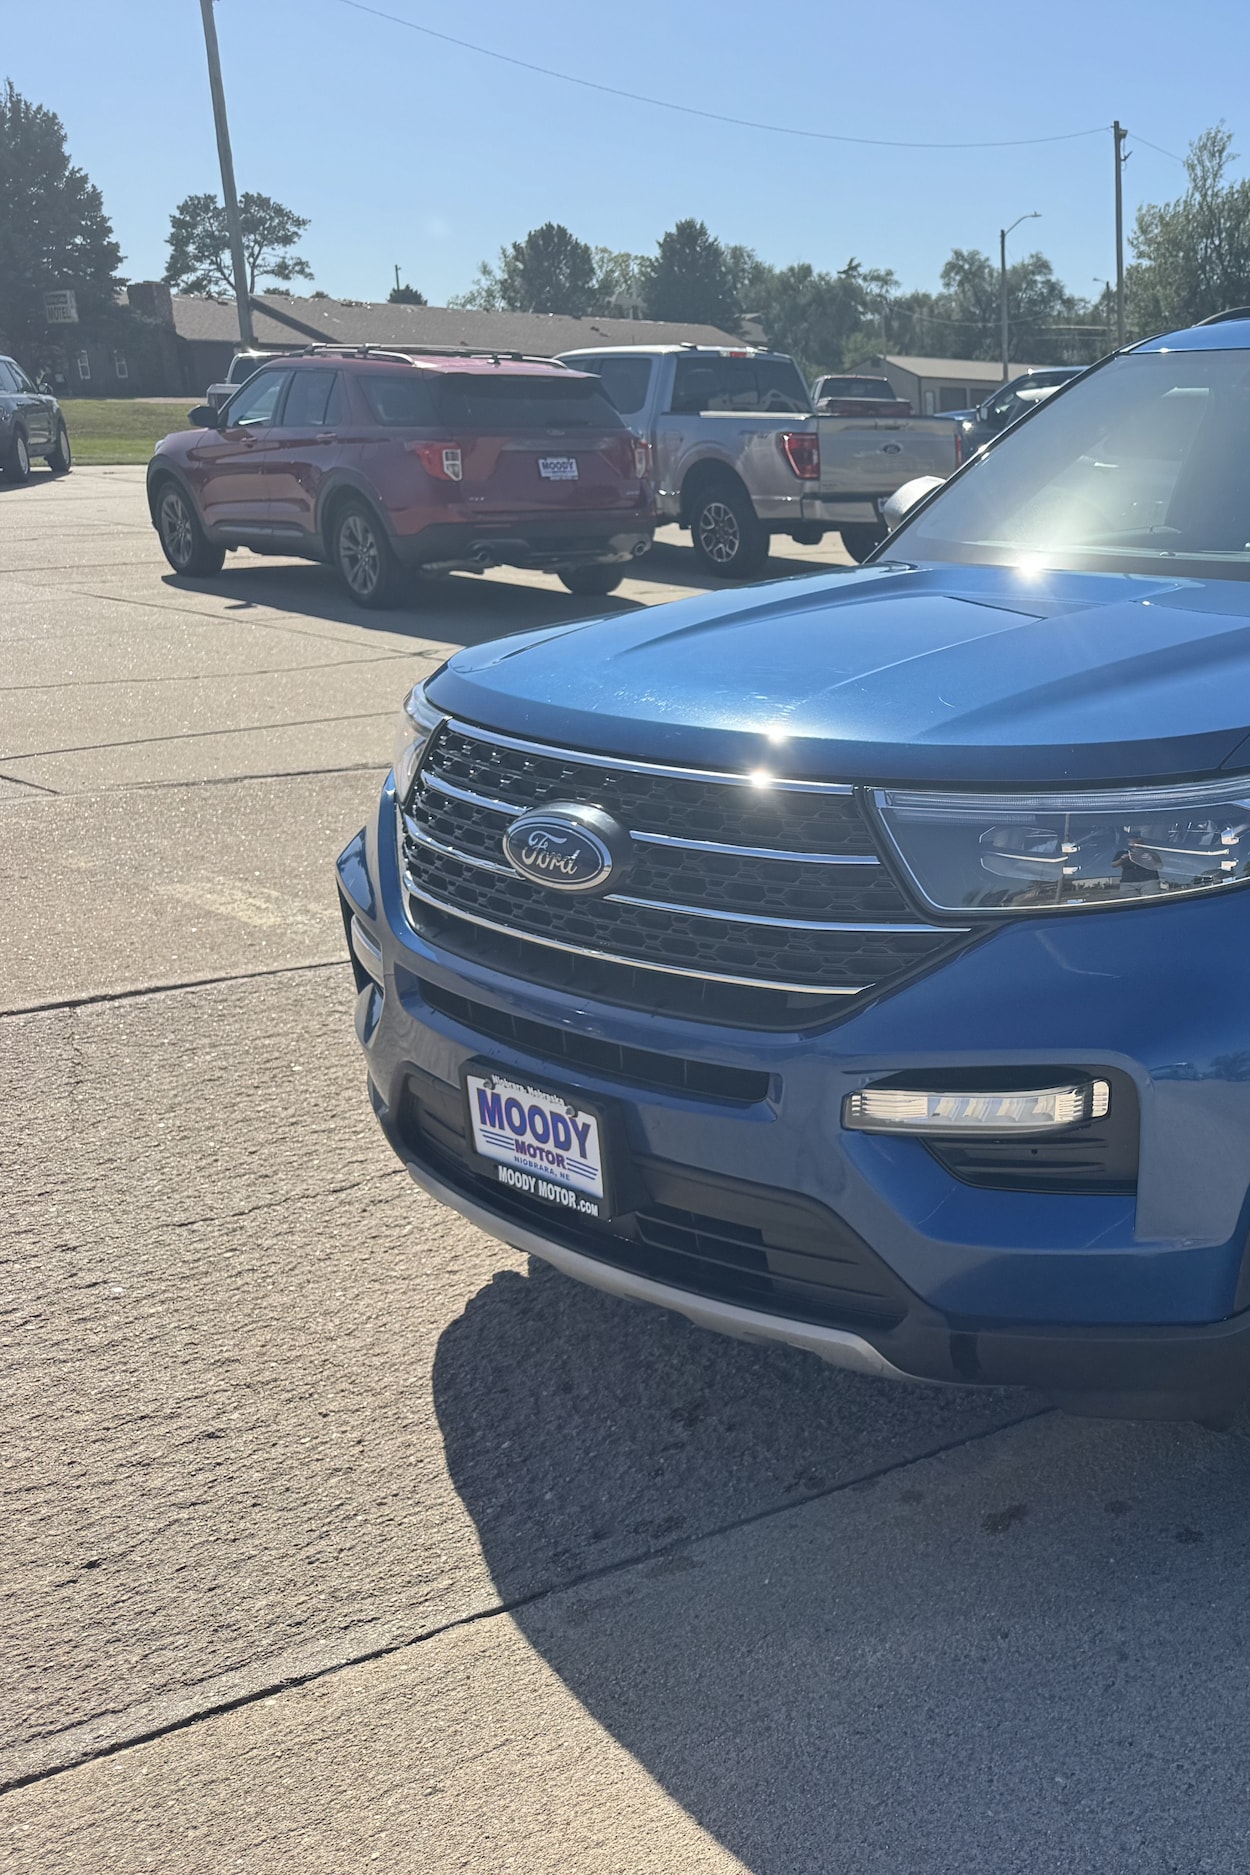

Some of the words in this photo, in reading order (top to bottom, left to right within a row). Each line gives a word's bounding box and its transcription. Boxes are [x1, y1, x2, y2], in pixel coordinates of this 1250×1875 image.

[521, 830, 581, 875] Ford
[476, 1087, 592, 1160] MOODY
[513, 1138, 567, 1170] MOTOR
[514, 1155, 558, 1177] NIOBRARA,
[559, 1171, 571, 1182] NE
[497, 1165, 536, 1194] MOODY
